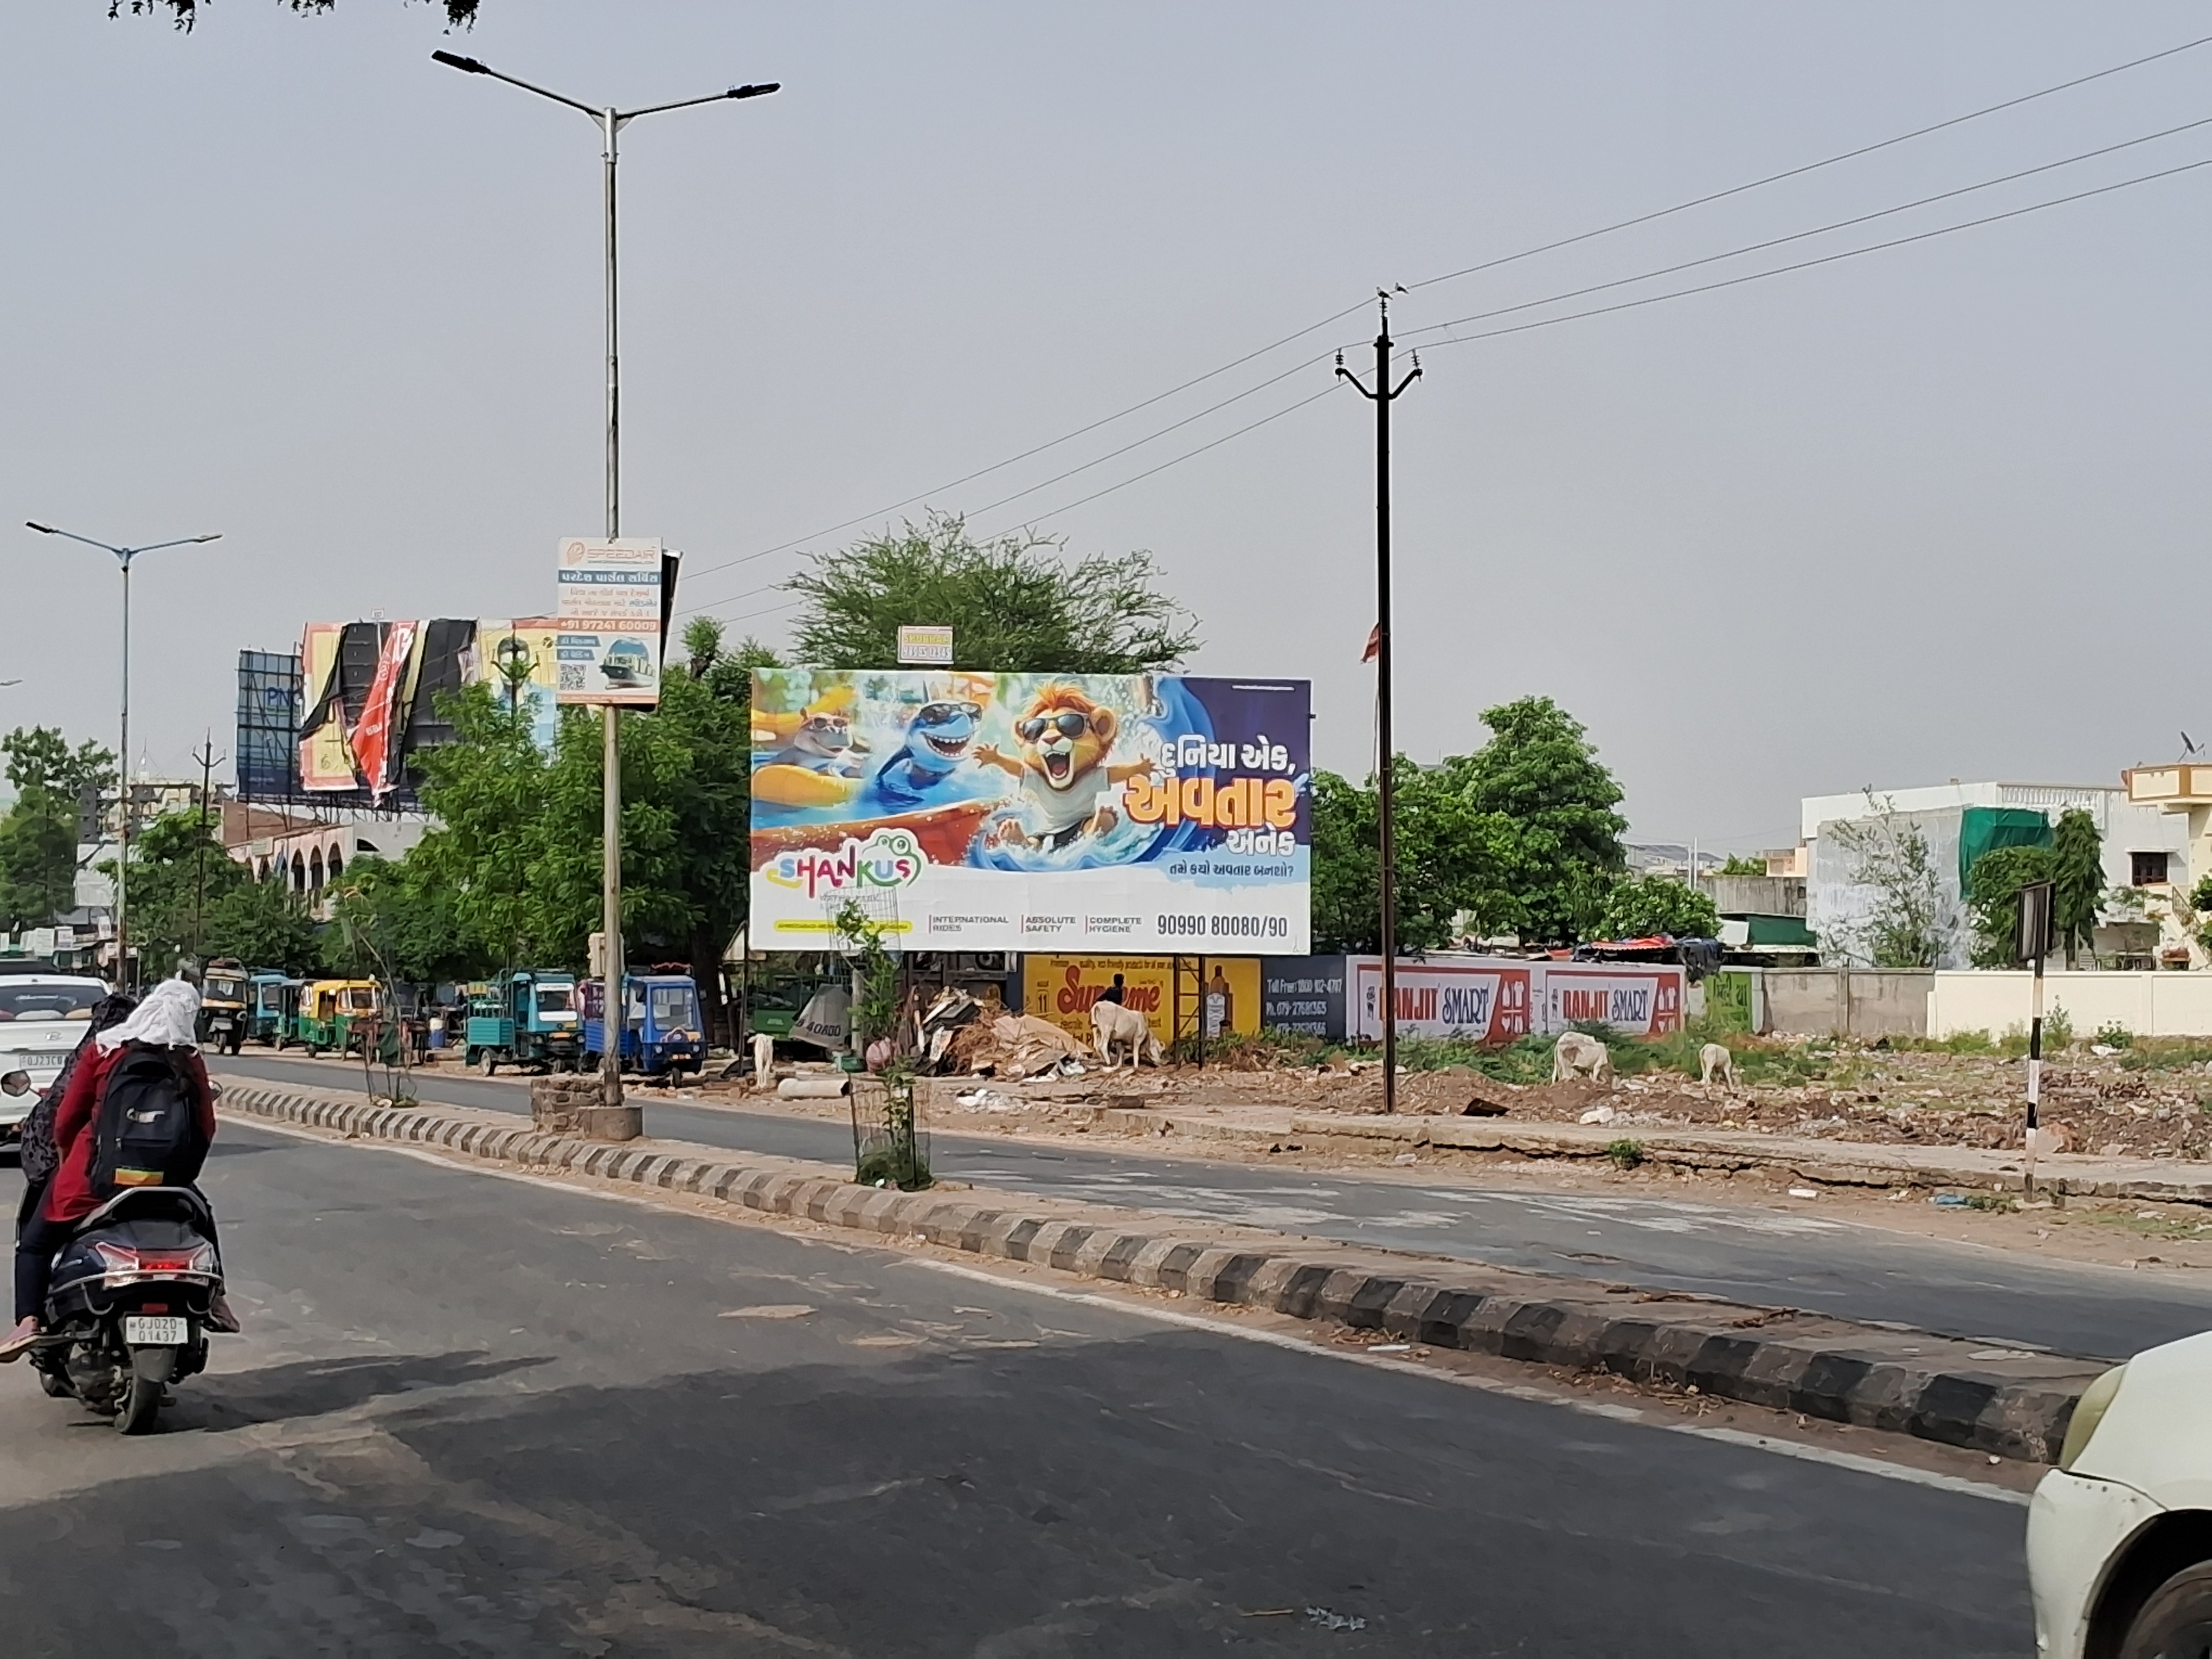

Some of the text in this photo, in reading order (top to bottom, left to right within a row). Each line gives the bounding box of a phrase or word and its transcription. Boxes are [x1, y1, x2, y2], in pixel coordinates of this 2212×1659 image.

[1160, 734, 1296, 777] દુનિયા એક,
[1124, 775, 1297, 829] અવતાર
[1225, 821, 1296, 857] અનેક
[779, 845, 911, 899] SHANKUS
[1169, 859, 1187, 874] તમે
[1213, 865, 1251, 876] અવતાર
[1089, 925, 1131, 933] HYGIENE
[1158, 914, 1288, 938] 90990 80080/90
[1442, 985, 1489, 1024] SMART
[1612, 988, 1648, 1021] SMART
